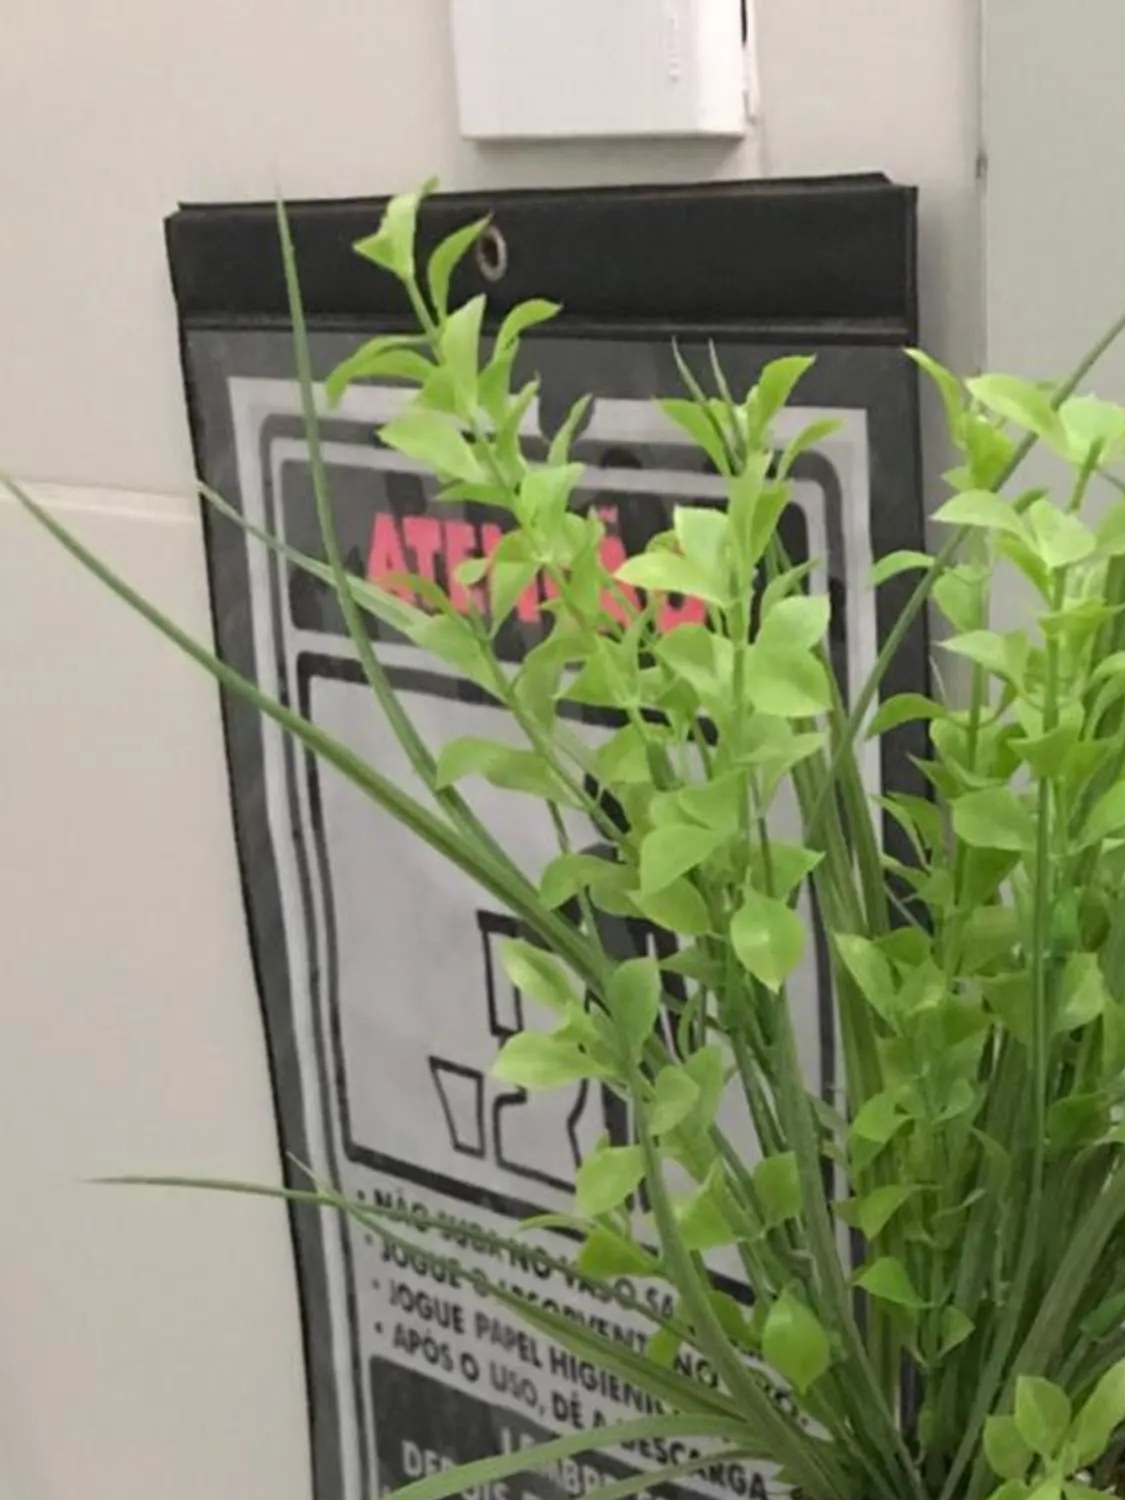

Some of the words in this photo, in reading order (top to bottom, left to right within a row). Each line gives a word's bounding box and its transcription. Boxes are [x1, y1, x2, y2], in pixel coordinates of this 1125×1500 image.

[389, 1279, 466, 1336] JOGUE
[474, 1311, 545, 1369] PAPEL
[393, 1324, 455, 1374] APÓS
[460, 1352, 481, 1383] O
[552, 1390, 585, 1430] DÊ
